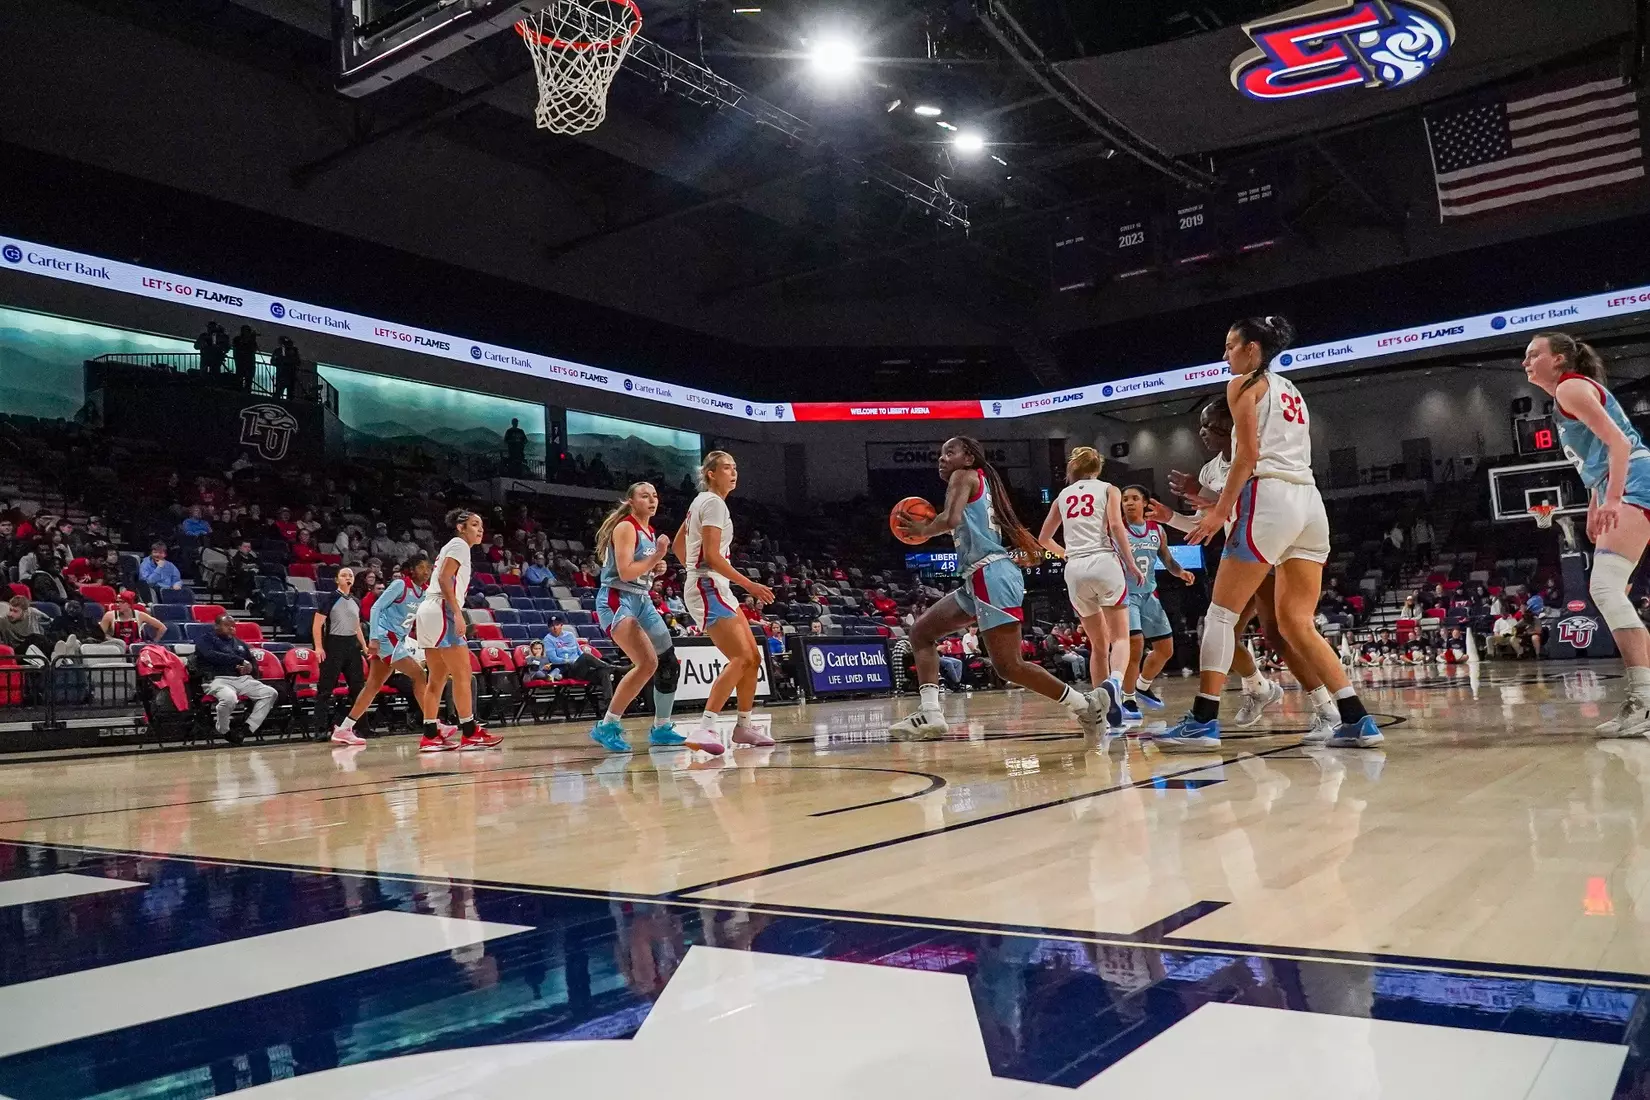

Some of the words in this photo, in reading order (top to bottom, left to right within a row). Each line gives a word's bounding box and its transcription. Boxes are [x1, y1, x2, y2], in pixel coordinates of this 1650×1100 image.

[1179, 213, 1204, 230] 2019
[1118, 231, 1144, 249] 2023
[28, 253, 72, 271] Carter
[76, 263, 110, 280] Bank
[143, 277, 172, 291] LET'S
[175, 285, 191, 295] GO
[196, 289, 243, 307] FLAMES
[1608, 296, 1636, 307] LET'S
[289, 309, 321, 323] Carter
[325, 316, 351, 330] Bank
[1510, 313, 1545, 324] Carter
[1548, 306, 1578, 318] Bank
[375, 328, 397, 339] LET'S
[399, 333, 412, 342] GO
[415, 336, 450, 350] FLAMES
[1378, 337, 1402, 347] LET'S
[1404, 334, 1418, 342] GO
[1422, 326, 1464, 340] FLAMES
[485, 351, 509, 363] Carter
[512, 357, 532, 368] Bank
[1296, 351, 1325, 361] Carter
[1328, 345, 1353, 356] Bank
[550, 365, 567, 375] LET'S
[568, 369, 578, 377] GO
[581, 372, 608, 384] FLAMES
[1185, 371, 1205, 380] LET'S
[635, 383, 654, 393] Carter
[656, 388, 672, 397] Bank
[1116, 384, 1140, 393] Carter
[1143, 378, 1164, 388] Bank
[687, 395, 700, 403] LET'S
[711, 399, 733, 410] FLAMES
[1022, 401, 1039, 409] LET'S
[1053, 393, 1083, 403] FLAMES
[1535, 429, 1552, 449] 18
[1066, 494, 1094, 519] 23
[930, 553, 958, 562] LIBERT
[940, 561, 956, 572] 48
[1035, 567, 1041, 575] 2
[827, 651, 859, 667] Carter
[860, 650, 887, 666] Bank
[828, 675, 842, 684] LIFE
[845, 674, 863, 683] LIVED
[867, 673, 882, 682] FULL
